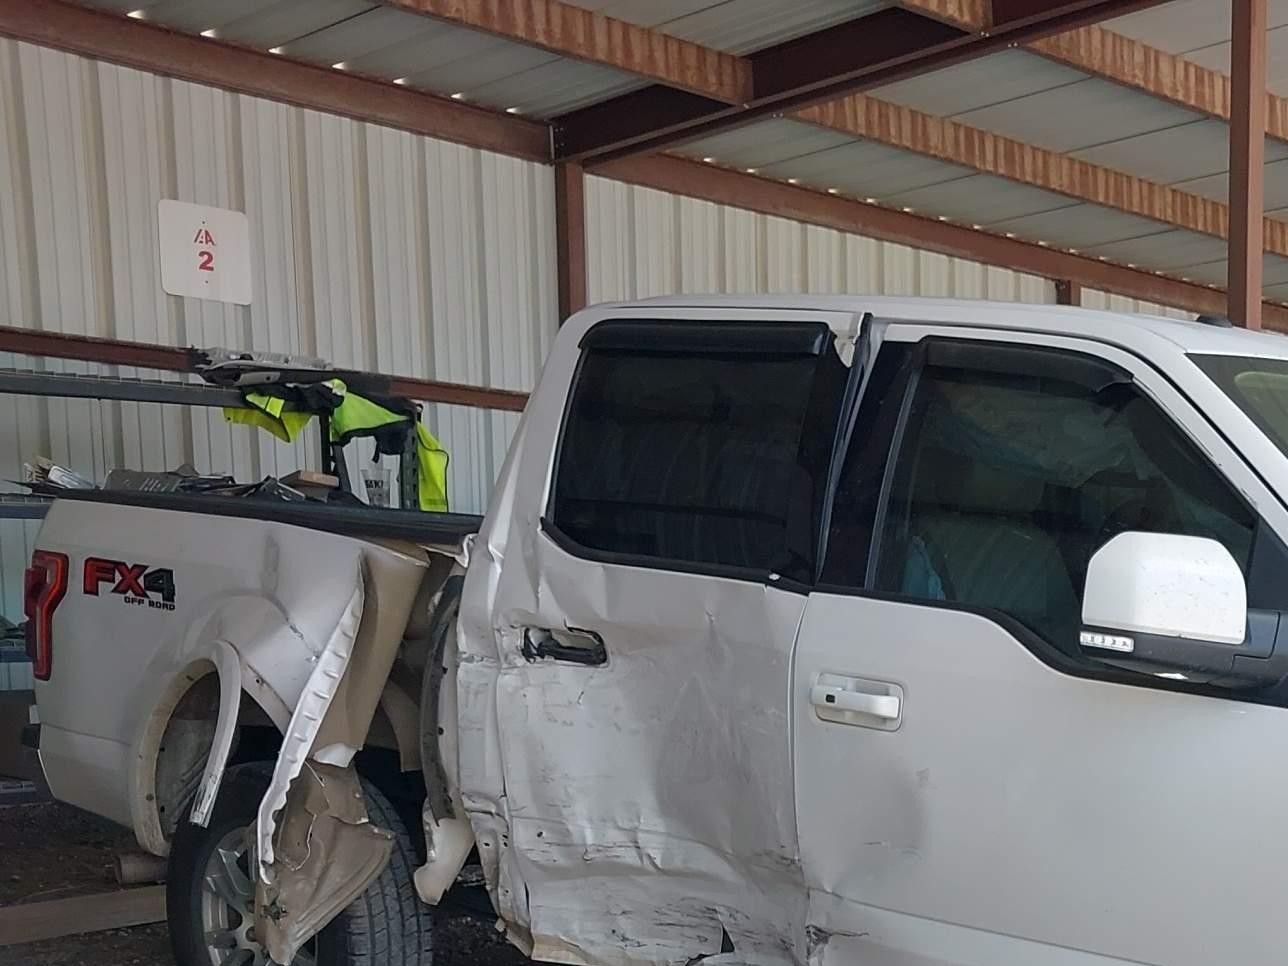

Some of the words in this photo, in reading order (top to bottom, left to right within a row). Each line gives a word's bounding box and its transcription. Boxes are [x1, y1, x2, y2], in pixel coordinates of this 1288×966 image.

[198, 251, 215, 271] 2
[83, 557, 176, 603] FX4
[123, 596, 145, 606] OFF
[148, 599, 176, 611] ROAD
